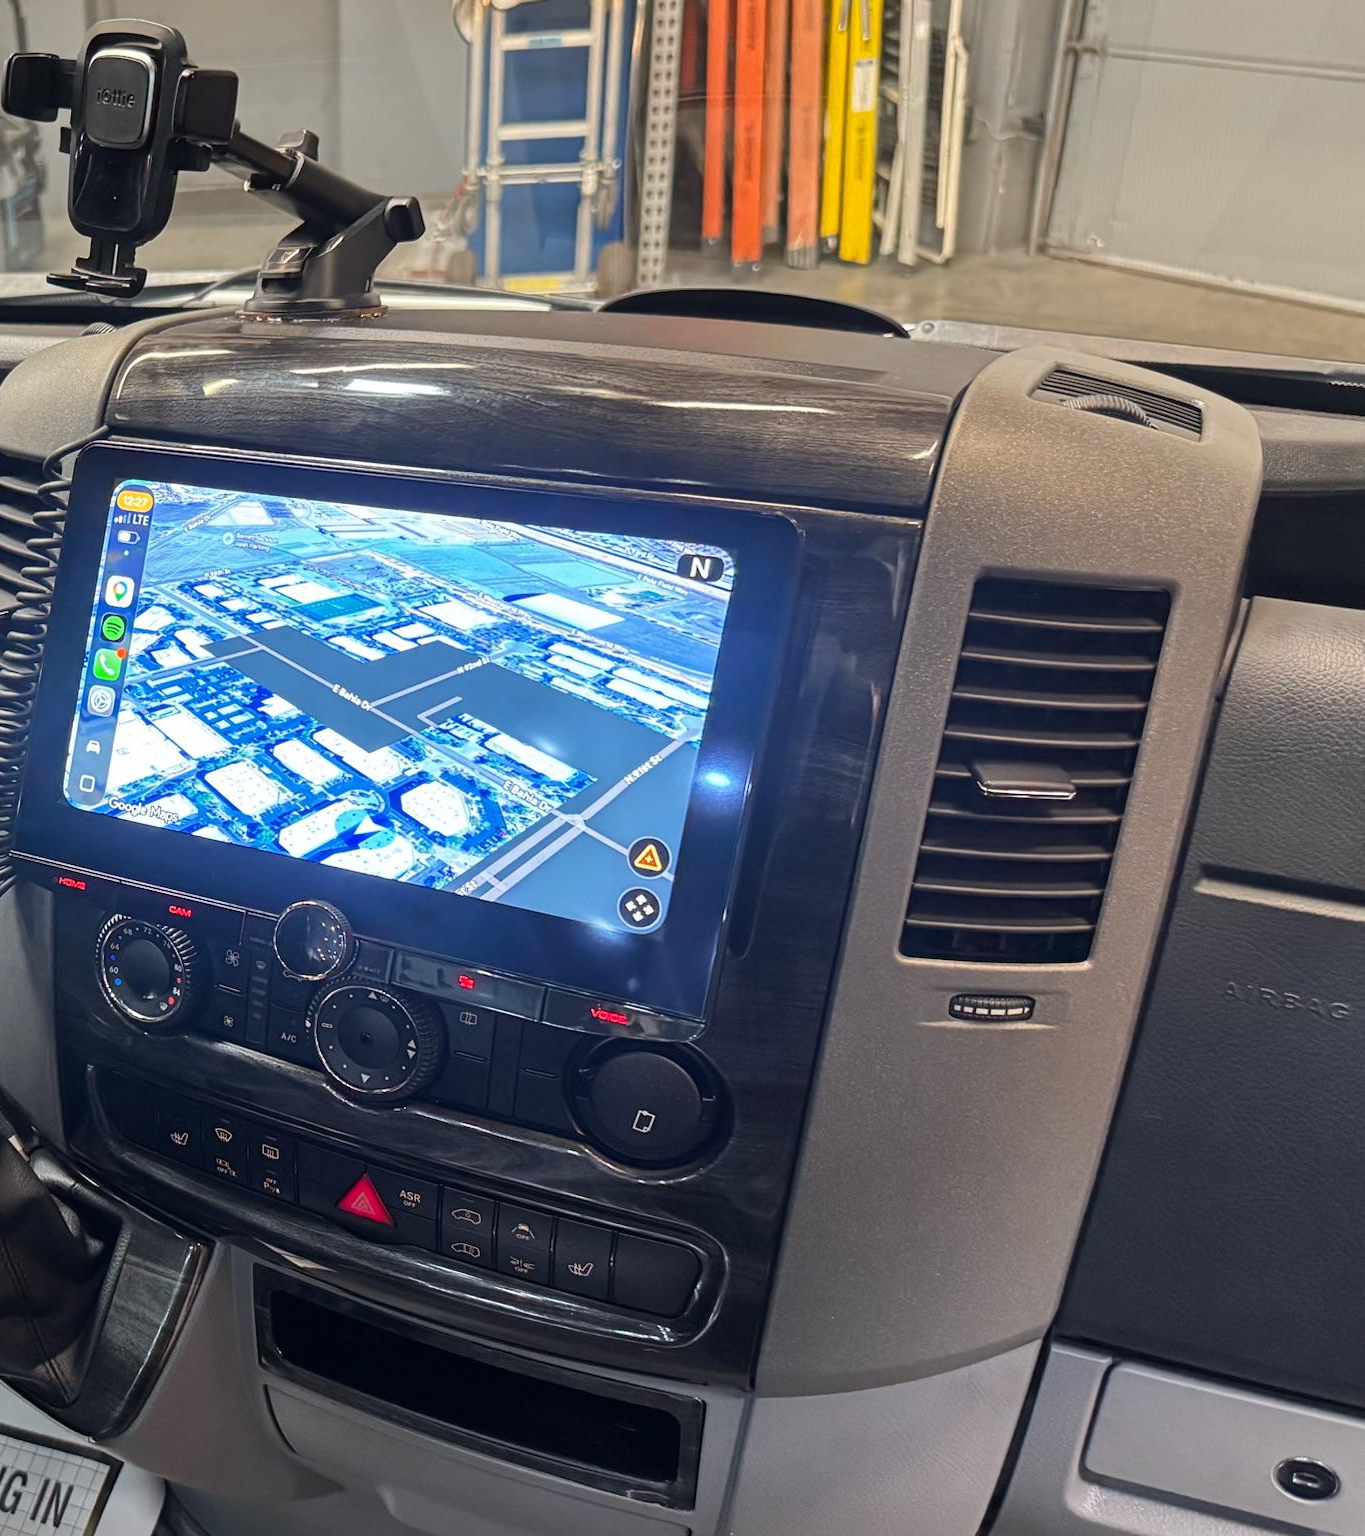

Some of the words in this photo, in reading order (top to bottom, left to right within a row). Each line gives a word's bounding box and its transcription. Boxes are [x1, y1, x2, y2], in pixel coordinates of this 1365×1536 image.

[97, 88, 135, 108] iOttie
[123, 495, 149, 508] 12:27
[132, 514, 150, 526] LTE
[690, 557, 711, 579] N
[332, 684, 340, 694] E
[361, 701, 372, 711] Dr
[503, 780, 511, 791] E
[538, 799, 553, 813] Dr
[109, 796, 148, 817] Google
[149, 805, 180, 823] Maps
[58, 876, 87, 891] HOME
[168, 905, 193, 918] CAM
[123, 928, 133, 936] 68
[143, 926, 152, 935] 72
[109, 966, 119, 974] 60
[174, 963, 182, 973] 80
[172, 986, 181, 996] 84
[1226, 981, 1350, 1019] AIRBAG
[590, 1008, 628, 1026] VOICE
[281, 1032, 297, 1043] A/C
[399, 1189, 421, 1203] ASR
[403, 1200, 416, 1208] OFF
[514, 1266, 528, 1274] OFF
[29, 1478, 74, 1529] IN
